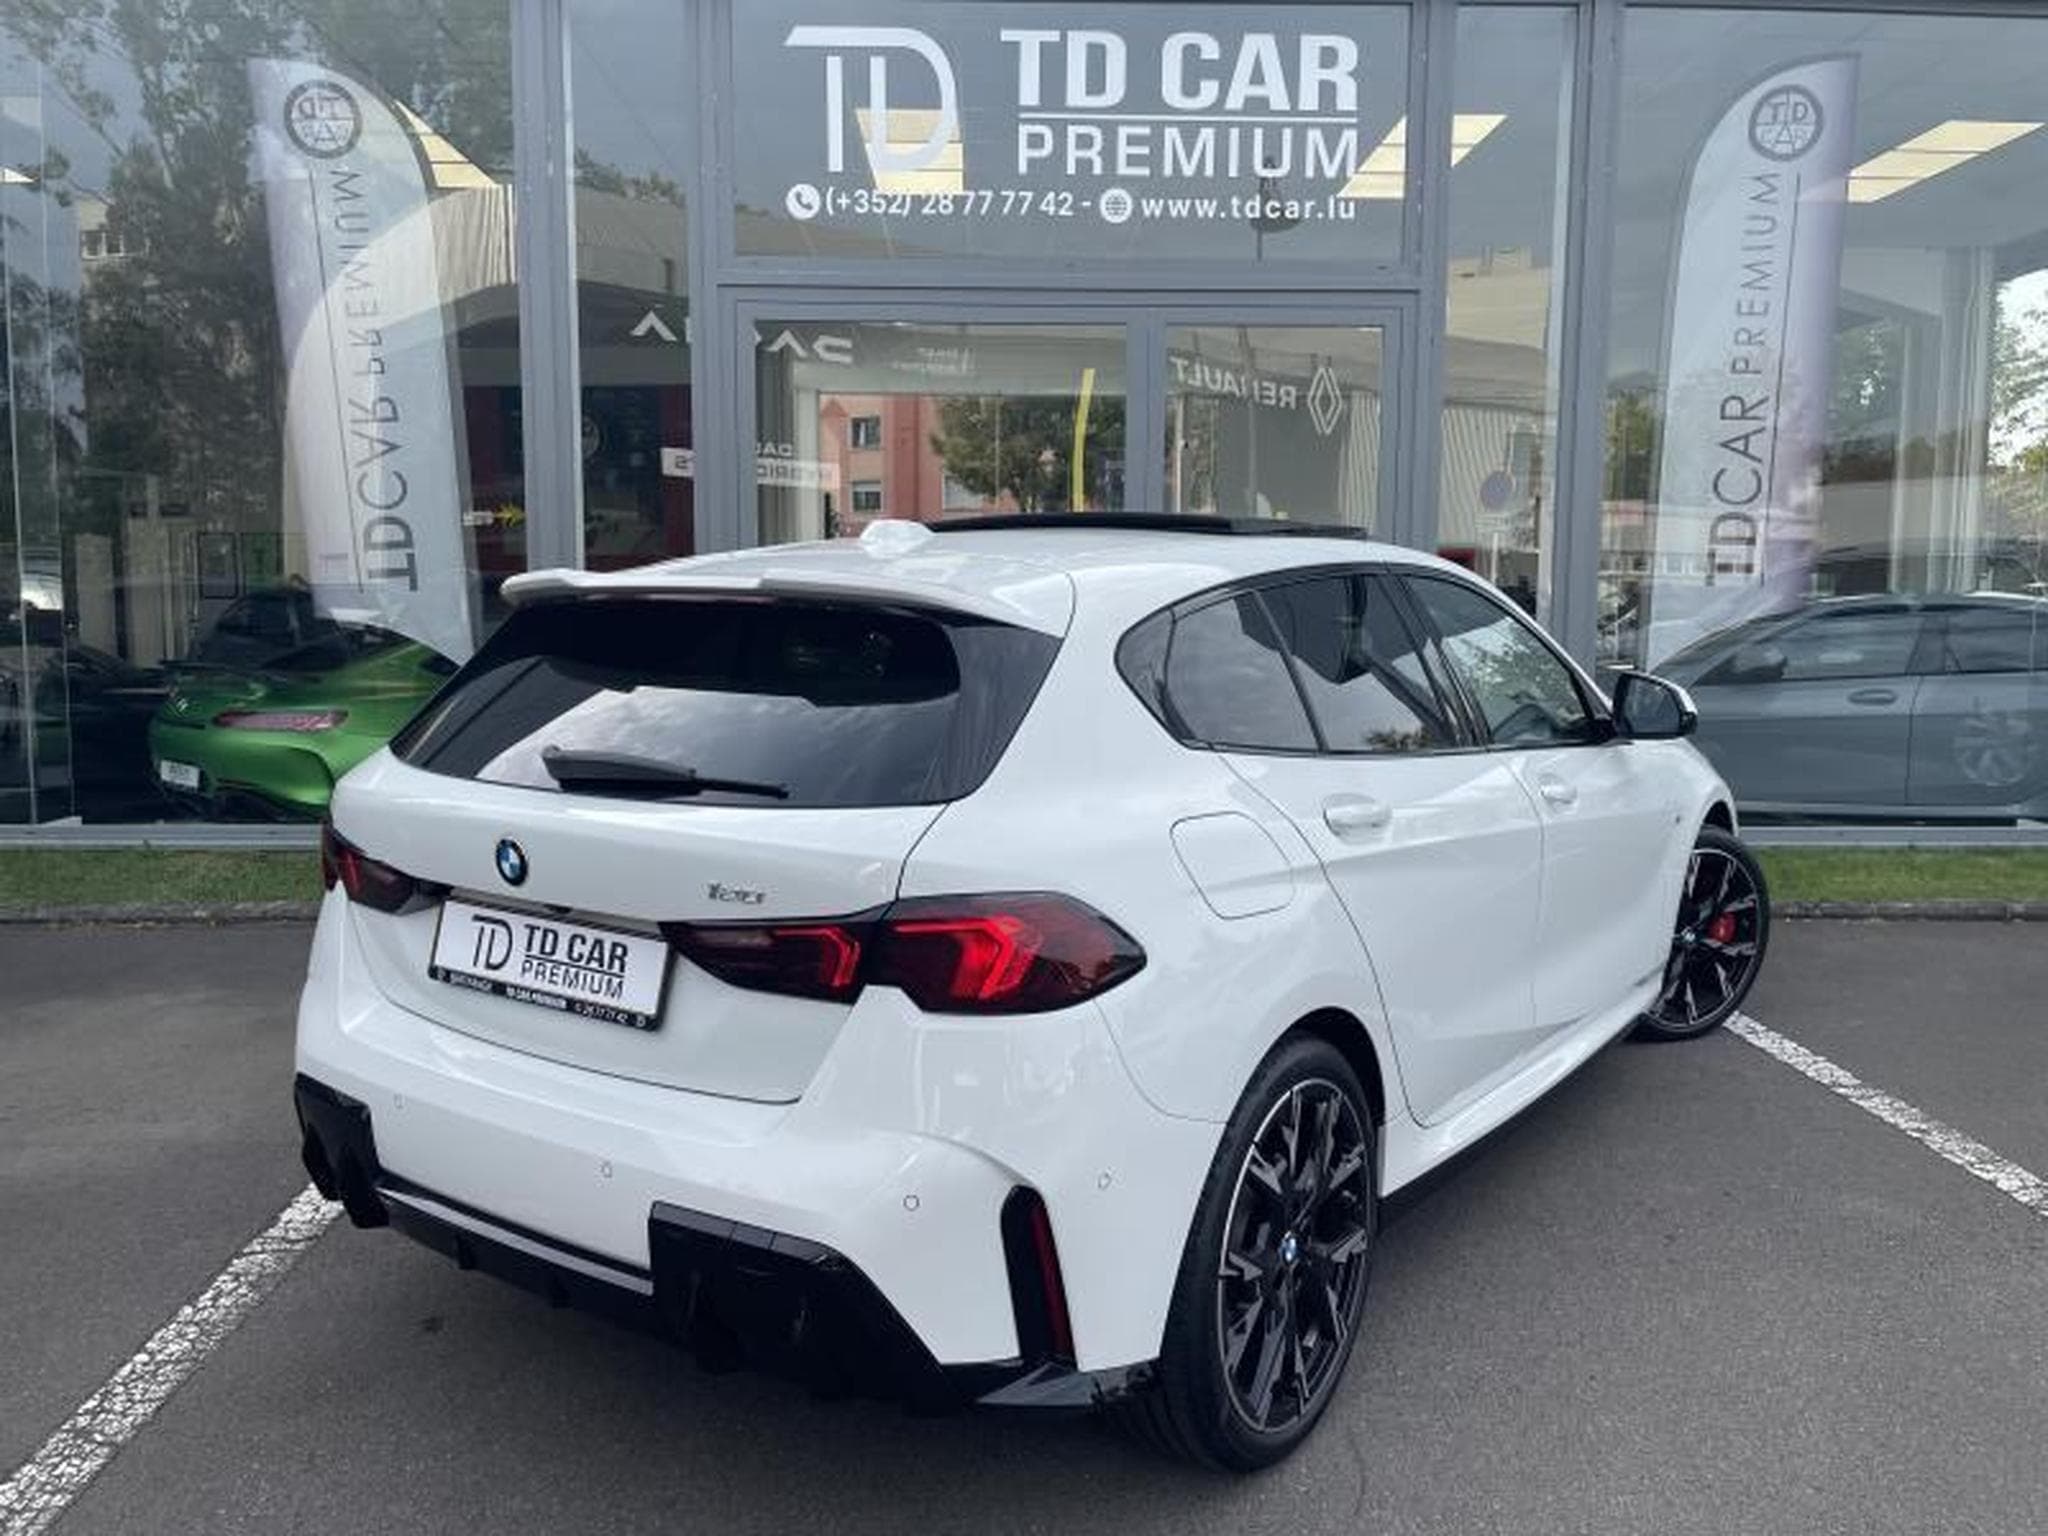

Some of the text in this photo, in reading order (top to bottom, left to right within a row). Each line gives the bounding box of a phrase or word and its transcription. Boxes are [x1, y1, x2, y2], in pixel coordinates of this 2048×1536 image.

[1001, 30, 1358, 111] TD CAR
[1018, 124, 1358, 179] PREMIUM
[826, 188, 911, 220] (+352)
[925, 190, 957, 216] 28
[961, 191, 994, 216] 77
[1002, 191, 1036, 216] 77
[1040, 192, 1075, 217] 42
[1141, 194, 1356, 220] www.tdcar.lu
[1730, 171, 1780, 376] PREMIUM
[524, 923, 628, 973] TD CAR
[521, 960, 623, 998] PREMIUM
